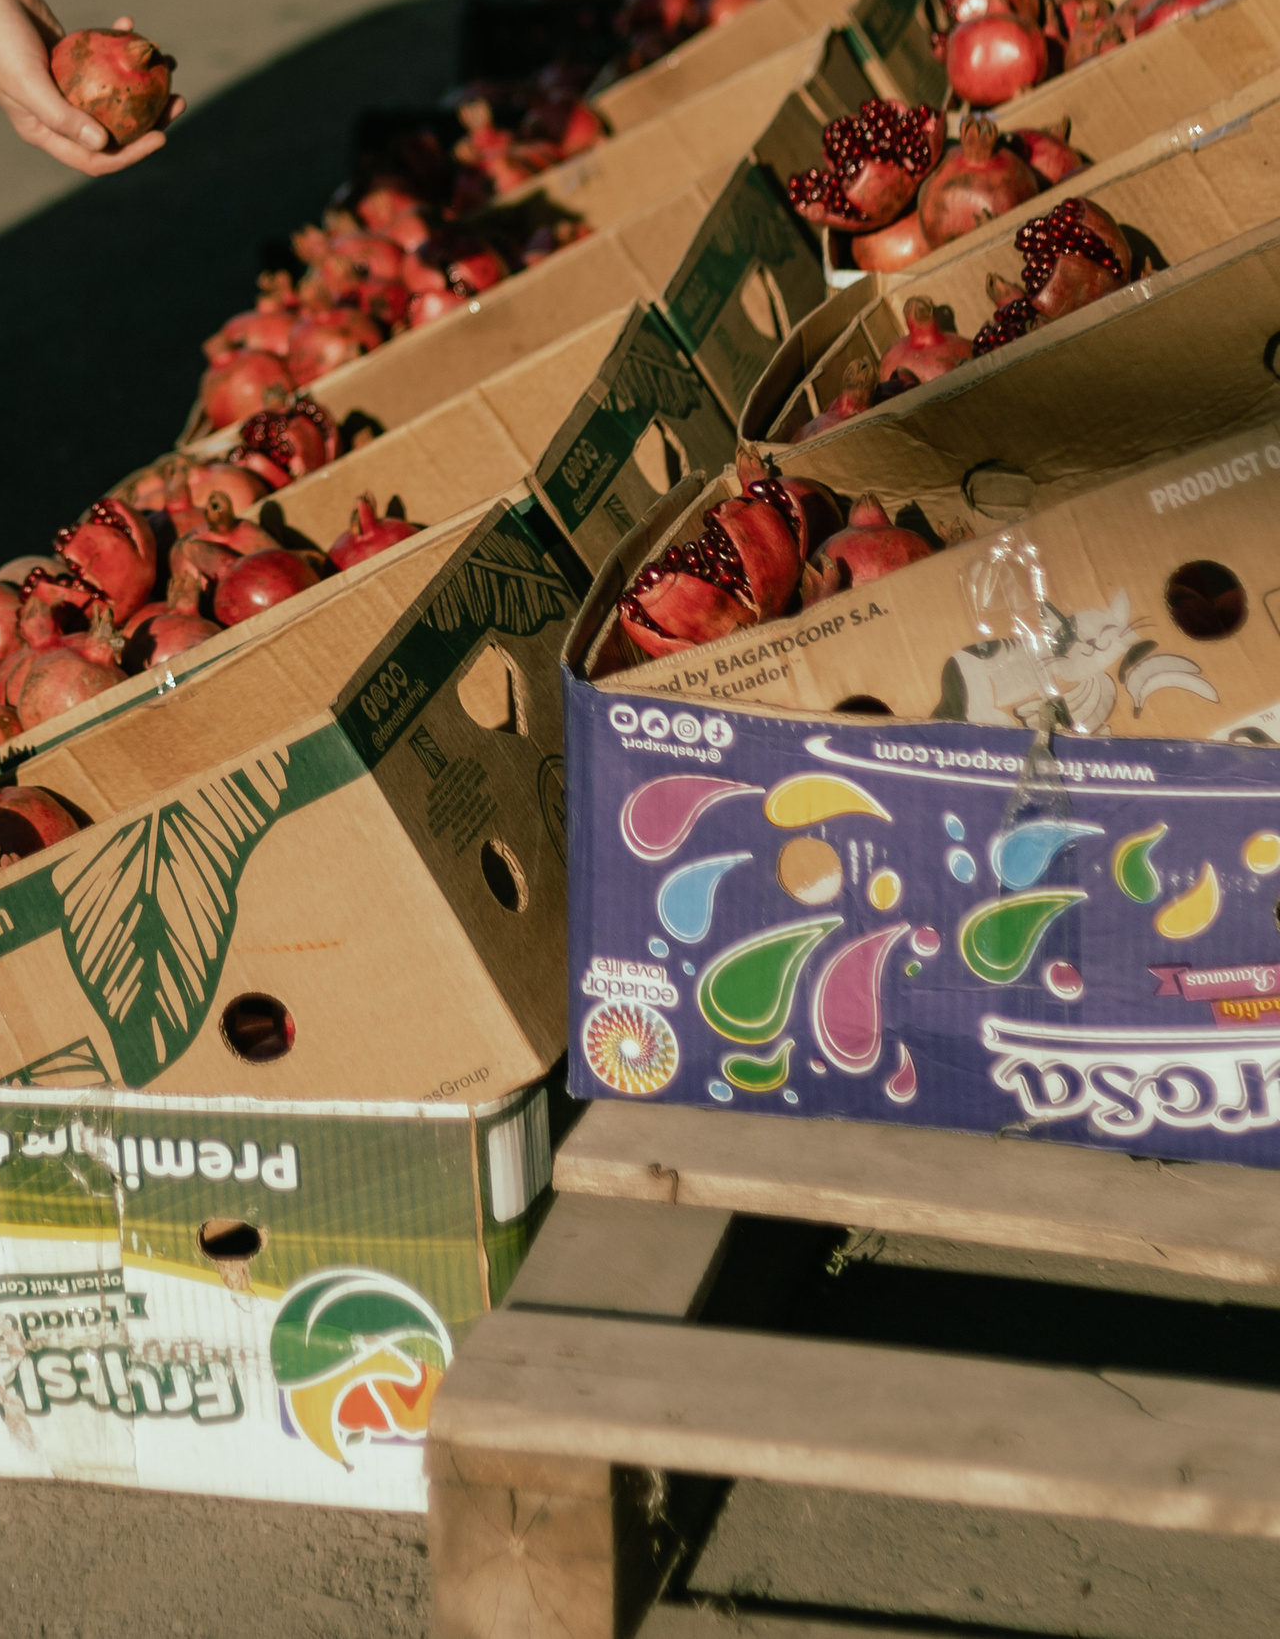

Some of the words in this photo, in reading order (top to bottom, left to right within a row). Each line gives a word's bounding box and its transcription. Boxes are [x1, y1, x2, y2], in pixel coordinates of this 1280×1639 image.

[1148, 451, 1262, 515] PRODUCT
[683, 668, 709, 688] by
[713, 616, 846, 676] BAGATOCORP
[849, 601, 890, 627] S.A.
[709, 666, 789, 698] Ecuador
[371, 678, 429, 752] @donatellafruit
[621, 736, 722, 763] @freshexport
[585, 974, 675, 1004] ecuador
[1186, 965, 1276, 992] Bananas
[999, 1056, 1280, 1132] rosa
[30, 1278, 70, 1295] Fruit
